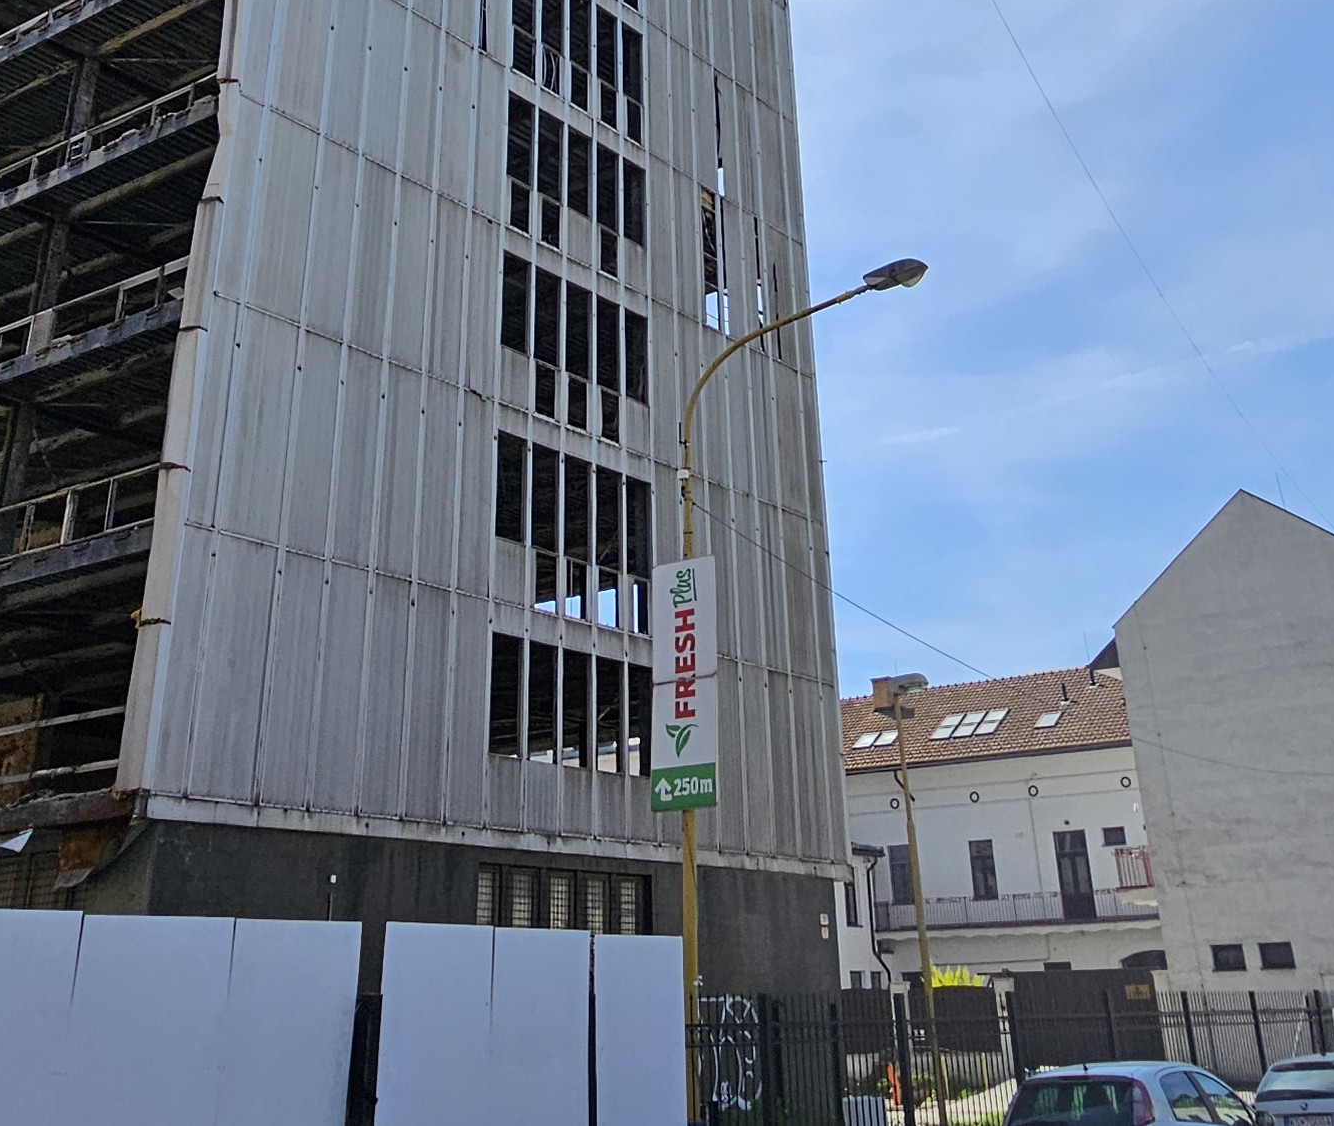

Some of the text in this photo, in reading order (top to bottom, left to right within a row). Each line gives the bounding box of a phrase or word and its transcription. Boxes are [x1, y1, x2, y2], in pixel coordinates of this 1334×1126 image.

[670, 568, 696, 720] FRESH Plus
[673, 776, 713, 797] 250m
